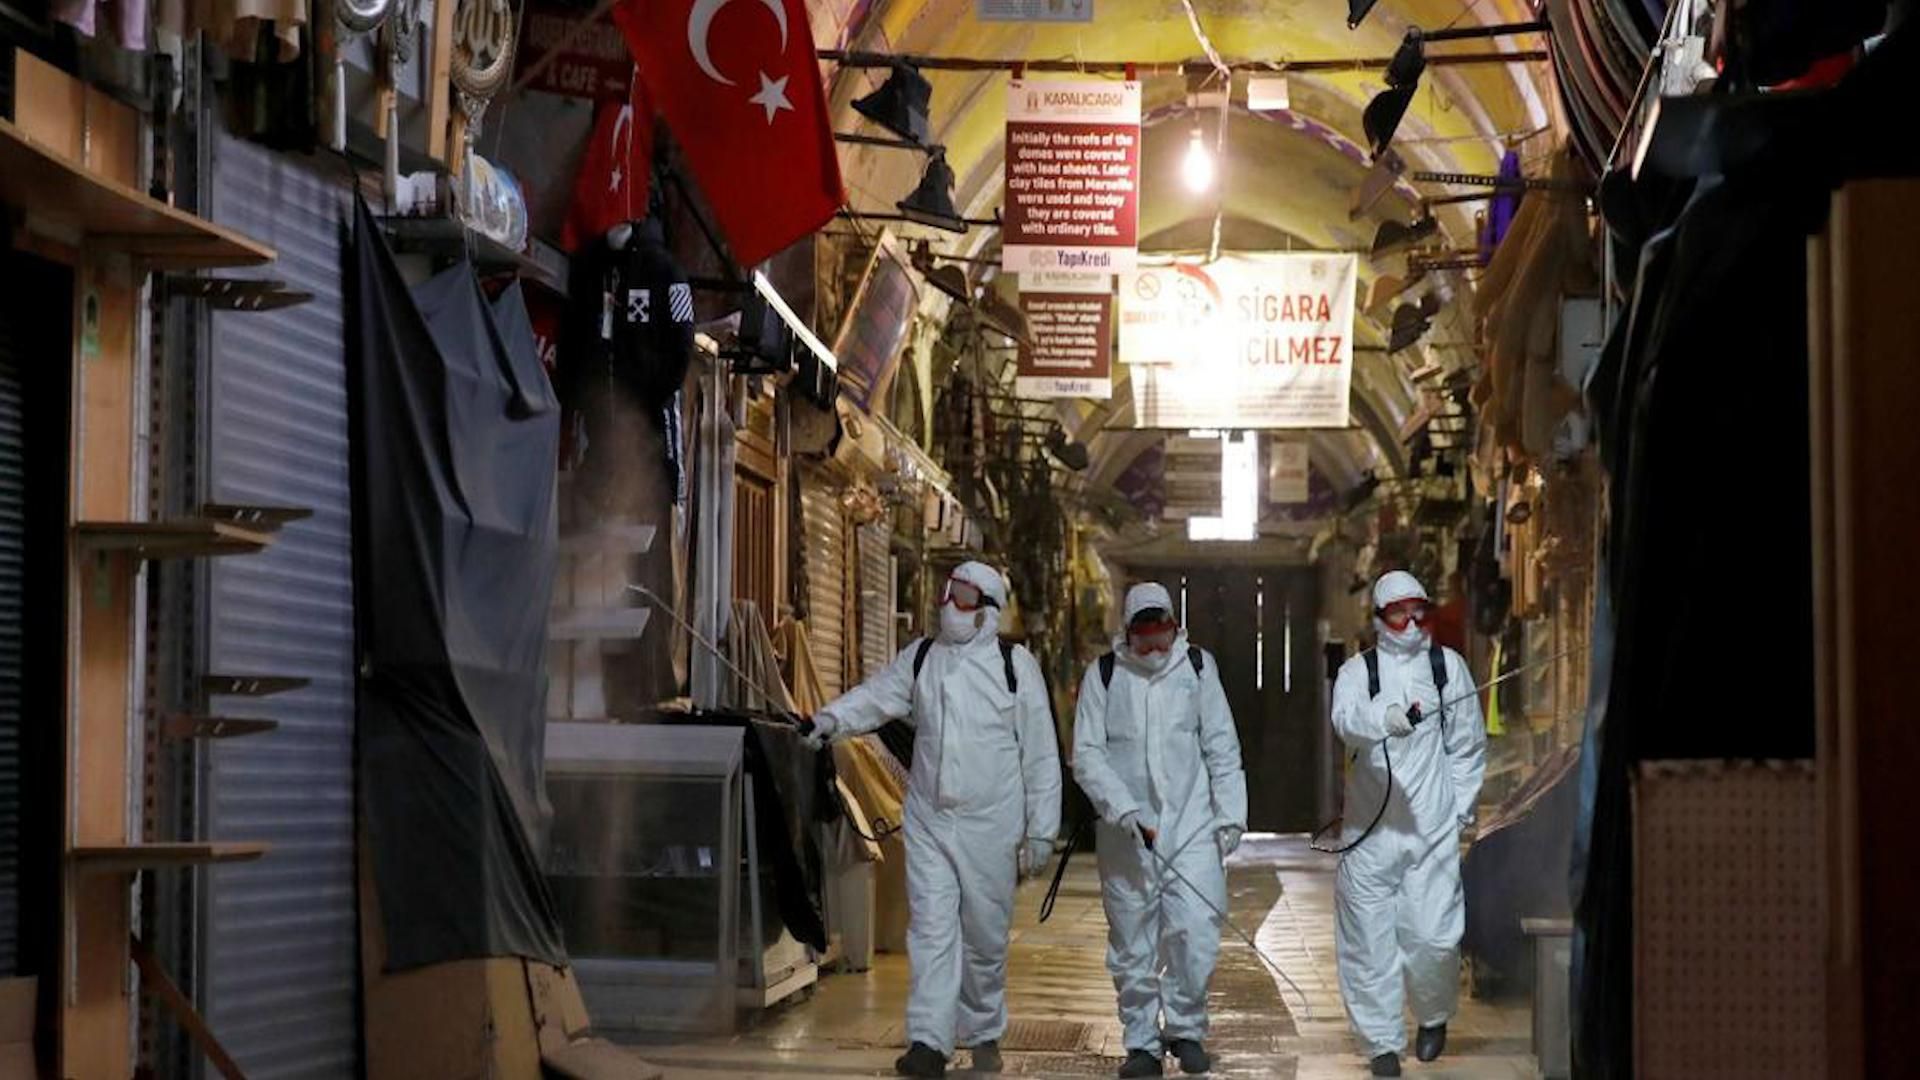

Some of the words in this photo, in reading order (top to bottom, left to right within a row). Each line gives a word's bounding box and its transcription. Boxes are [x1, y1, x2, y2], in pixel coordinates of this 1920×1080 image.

[561, 64, 598, 92] CAFE
[1012, 133, 1050, 147] Initially
[1052, 133, 1070, 145] the
[1072, 133, 1100, 146] roofs
[1102, 132, 1113, 145] of
[1114, 132, 1133, 145] the
[1018, 148, 1053, 160] domes
[1055, 150, 1081, 160] were
[1083, 148, 1126, 161] covered
[1013, 163, 1037, 174] with
[1038, 163, 1060, 175] lead
[1063, 163, 1100, 175] sheets.
[1102, 163, 1132, 176] Later
[1009, 178, 1030, 190] clay
[1032, 178, 1056, 189] tiles
[1058, 178, 1083, 189] from
[1085, 178, 1133, 190] Marseille
[1017, 195, 1044, 204] were
[1046, 193, 1071, 204] used
[1073, 193, 1093, 205] and
[1094, 193, 1125, 207] today
[1027, 208, 1051, 221] they
[1053, 210, 1071, 219] are
[1073, 208, 1114, 220] covered
[1021, 223, 1046, 234] with
[1047, 223, 1091, 237] ordinary
[1093, 223, 1119, 236] tiles.
[1237, 285, 1332, 323] SİGARA
